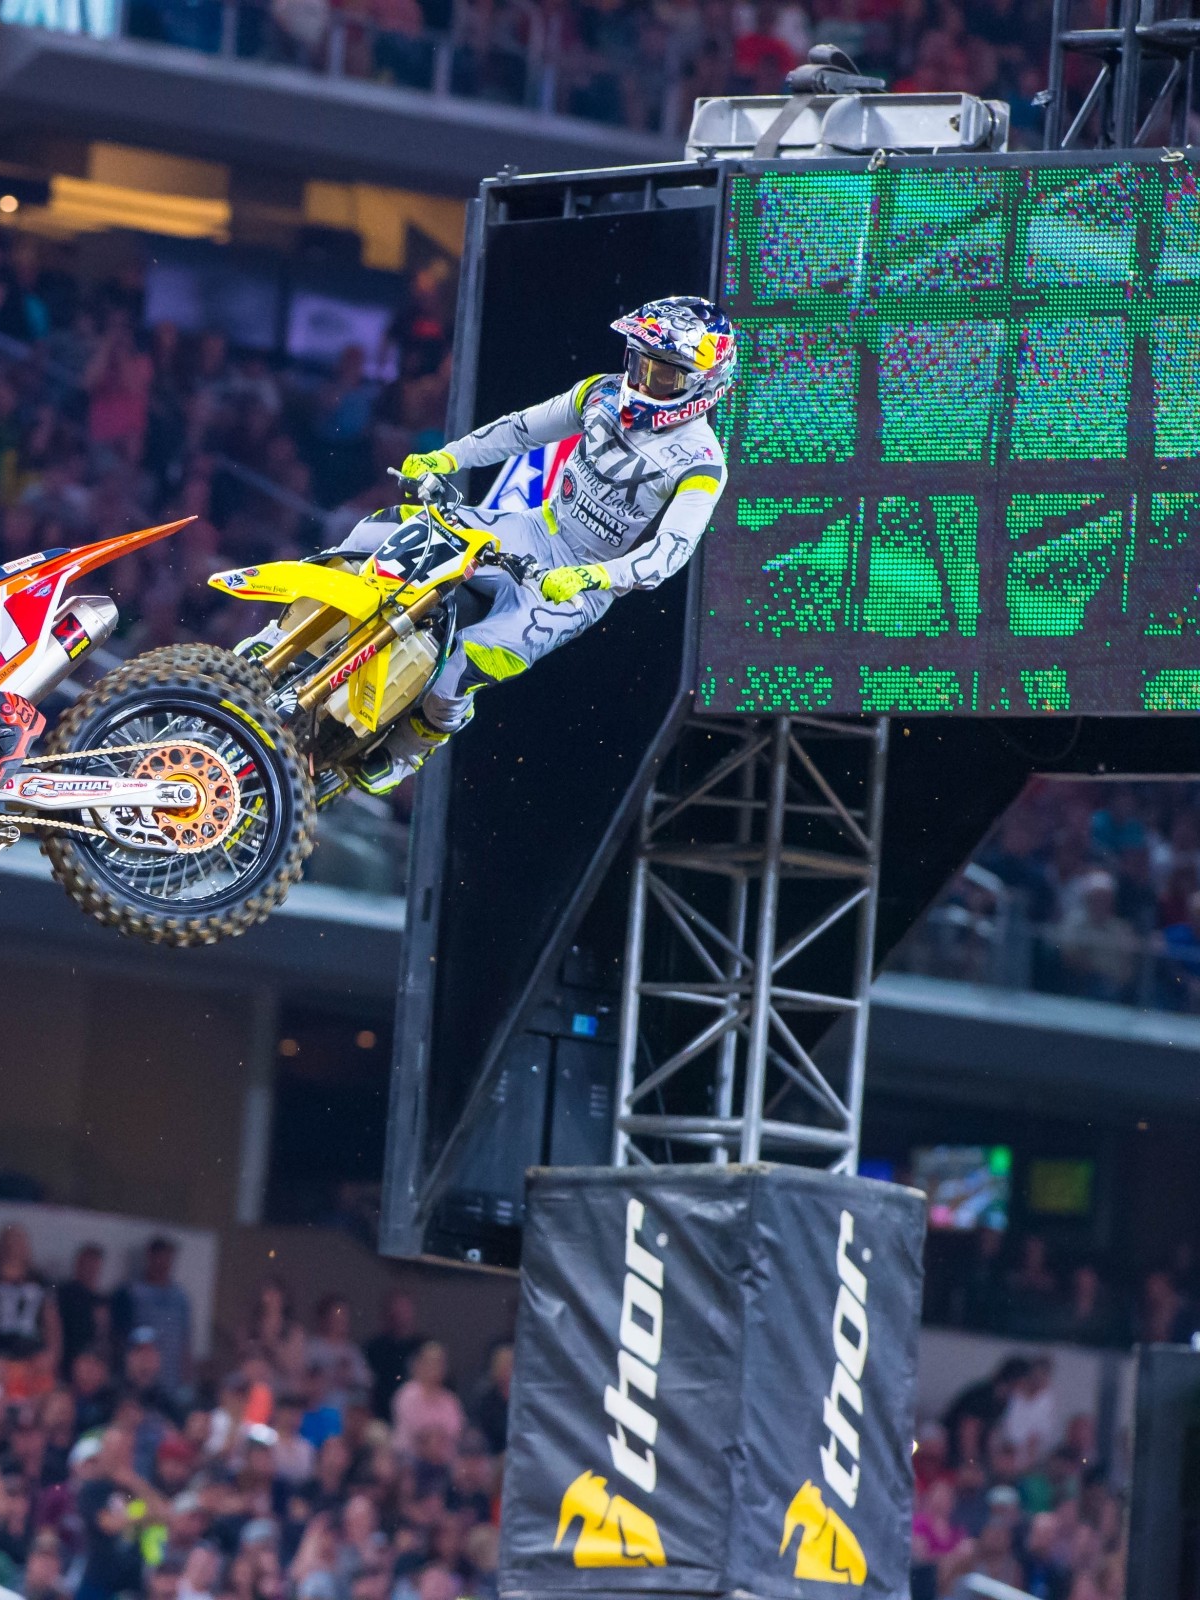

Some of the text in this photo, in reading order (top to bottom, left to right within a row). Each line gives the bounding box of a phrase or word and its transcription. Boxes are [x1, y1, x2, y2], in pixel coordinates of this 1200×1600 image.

[615, 321, 662, 346] Red Bull
[652, 402, 695, 429] Red
[576, 491, 629, 535] JIMMY
[599, 486, 652, 520] Eagle
[571, 502, 623, 548] JOHN'S
[373, 522, 461, 584] 94
[20, 776, 113, 798] RENTHAL
[122, 781, 148, 789] brembo
